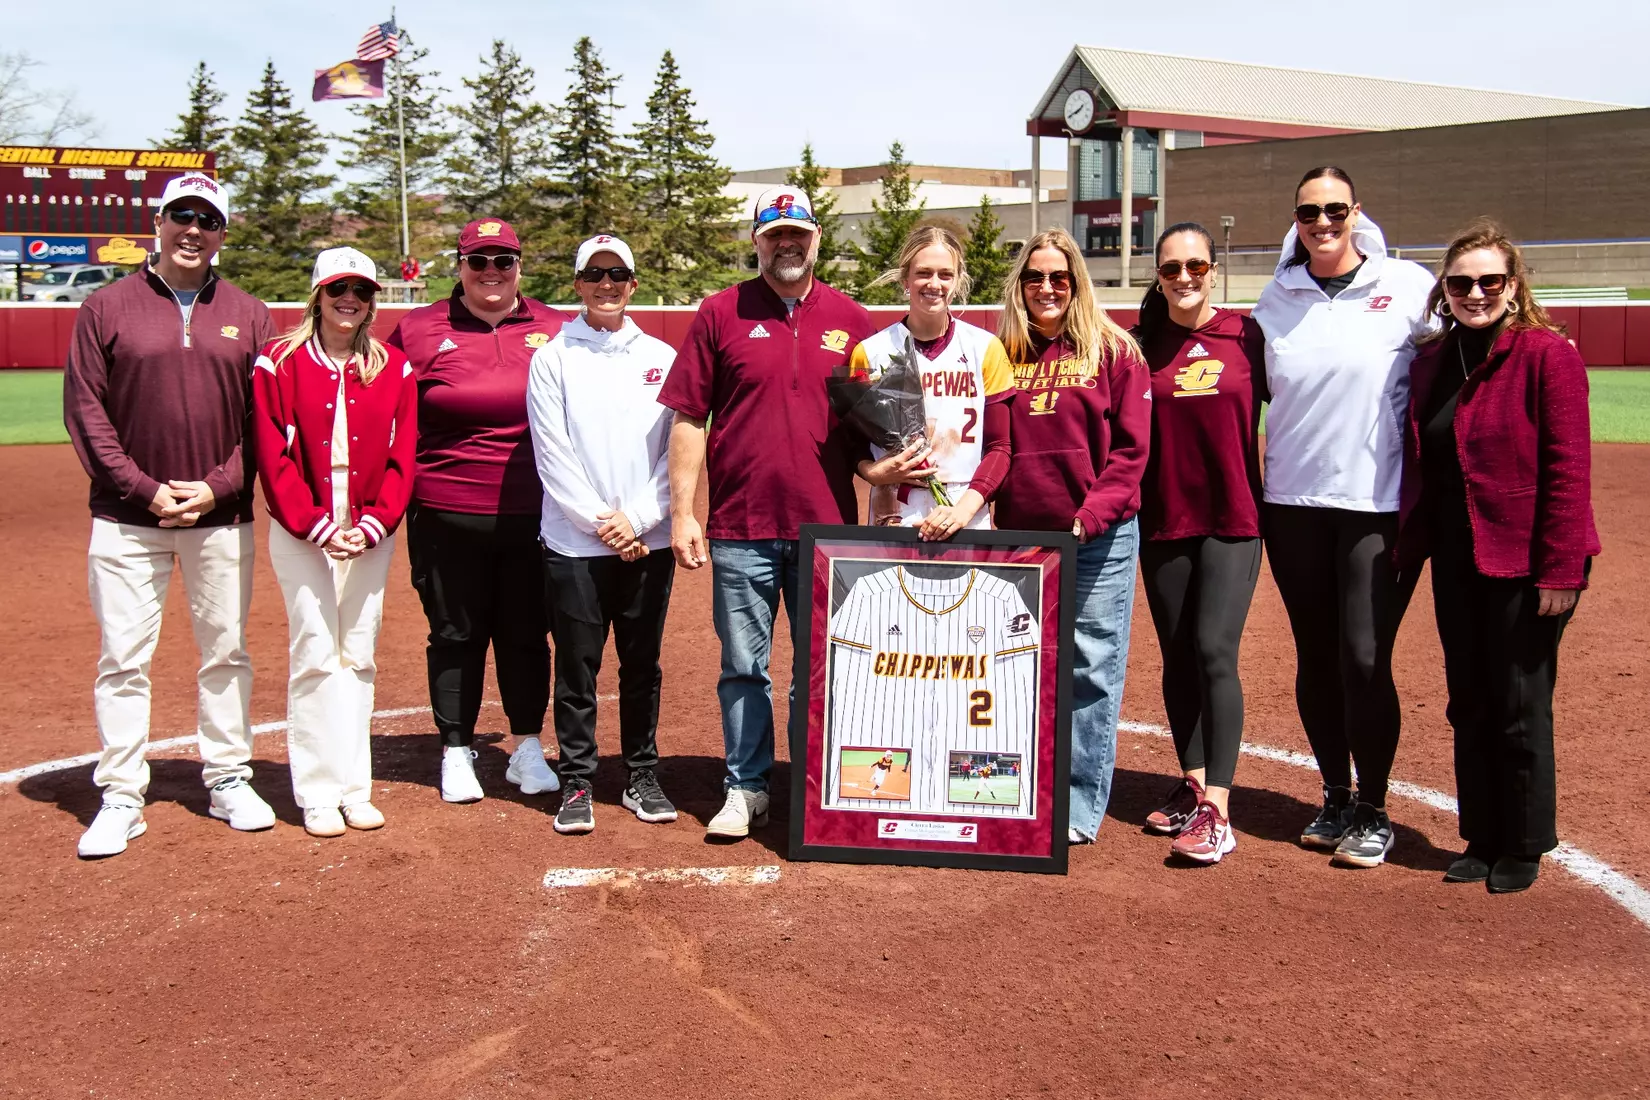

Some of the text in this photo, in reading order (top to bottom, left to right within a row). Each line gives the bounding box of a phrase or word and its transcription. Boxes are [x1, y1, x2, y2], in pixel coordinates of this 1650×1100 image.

[59, 149, 135, 166] MICHIGAN
[136, 151, 206, 168] SOFTBALL
[23, 166, 52, 178] BALL
[68, 168, 106, 179] STRIKE
[125, 169, 147, 181] OUT
[6, 194, 13, 204] 1
[19, 194, 26, 204] 2
[32, 194, 40, 204] 3
[48, 195, 56, 204] 4
[62, 195, 69, 205] 5
[75, 195, 83, 205] 6
[91, 196, 99, 206] 7
[131, 197, 142, 206] 10
[922, 371, 978, 398] PEWAS
[1174, 360, 1225, 391] C
[961, 408, 978, 443] 2
[873, 651, 989, 680] CHIPPEWAS
[970, 690, 992, 726] 2
